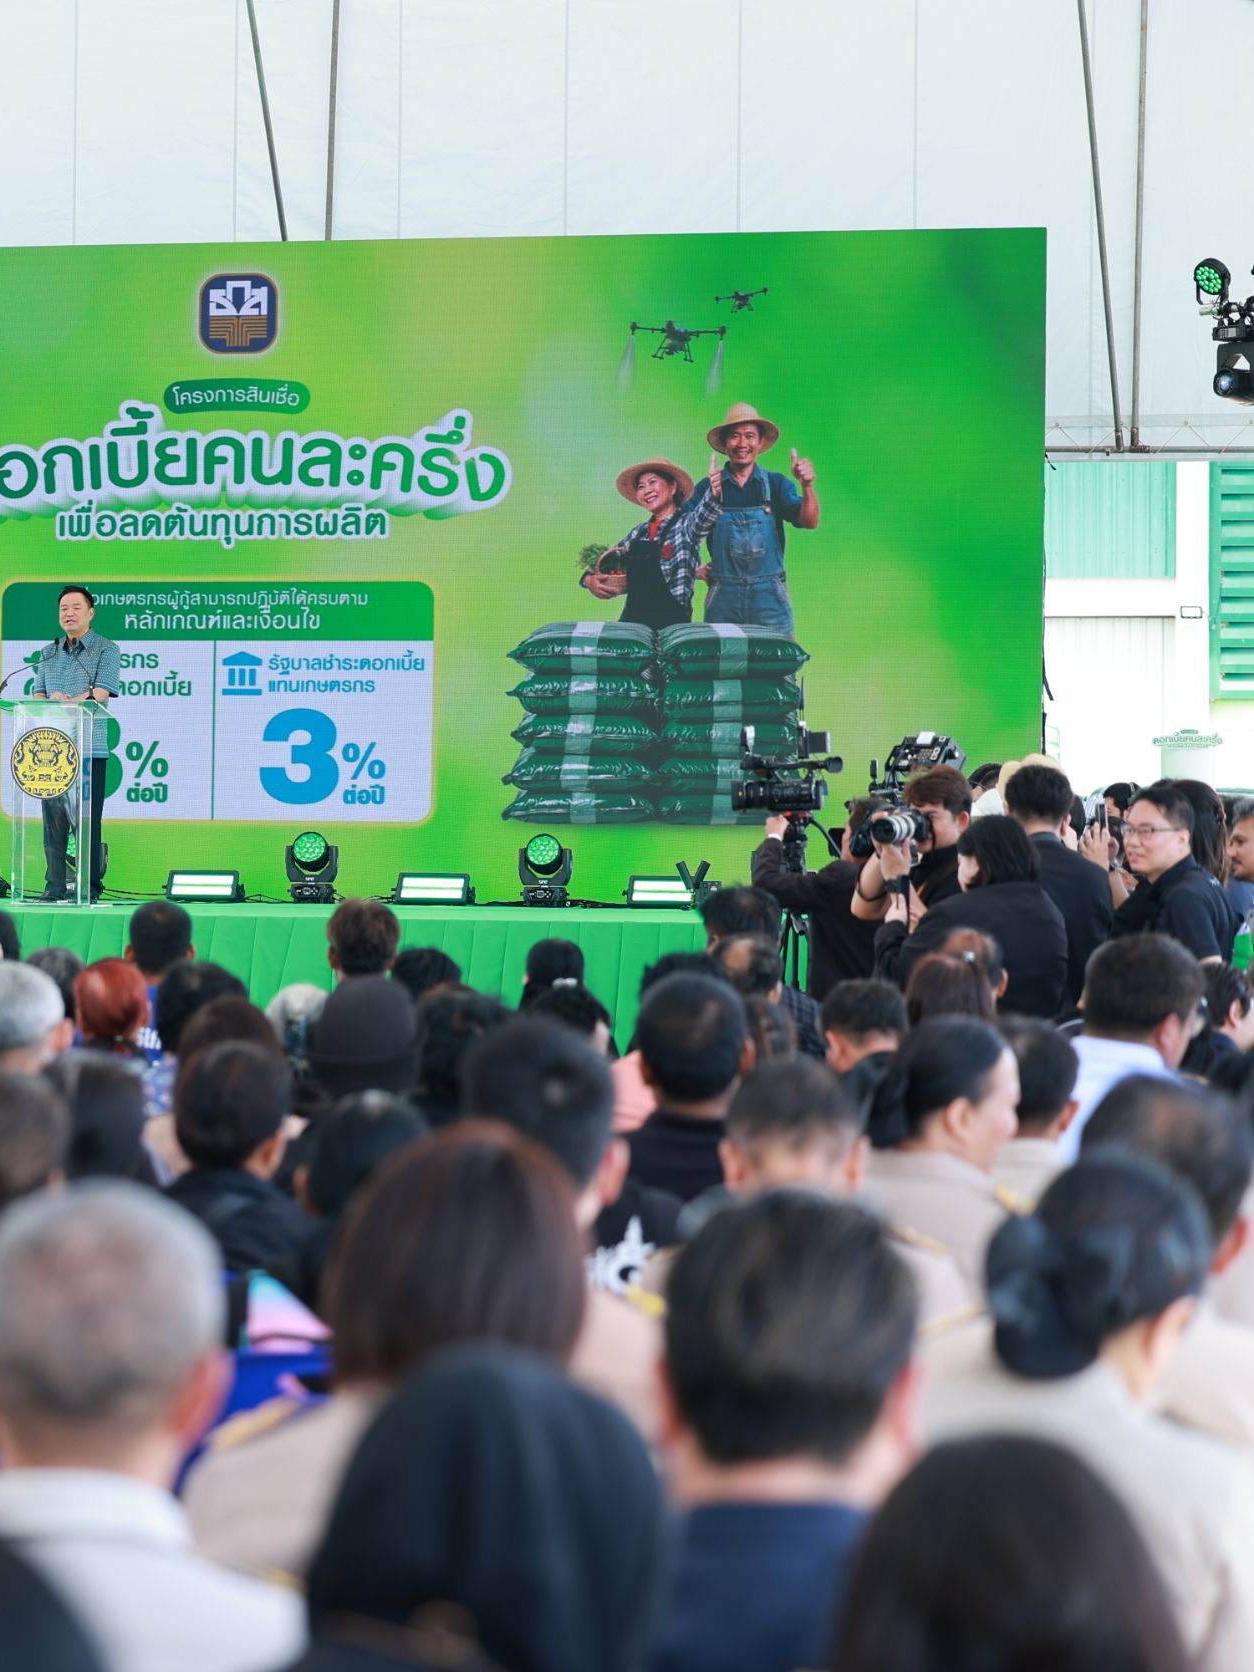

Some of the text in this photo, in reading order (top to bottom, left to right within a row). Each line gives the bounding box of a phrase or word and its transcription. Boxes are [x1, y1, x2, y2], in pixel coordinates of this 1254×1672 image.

[172, 384, 300, 406] โครงการสินเชื่อ
[59, 499, 387, 545] เพื่อลดต้นทุนการผลิต
[85, 586, 368, 610] อเกษตรกรผู้กู้สามารถปฏิบัติได้ครบตาม
[124, 605, 321, 630] หลักเกณฑ์และเงื่อนไข
[268, 650, 425, 675] รัฐบาลชำระดอกเบี้ย
[268, 679, 376, 693] แทนเกษตรกร
[126, 782, 168, 803] ต่อปี
[342, 784, 386, 805] ต่อปี
